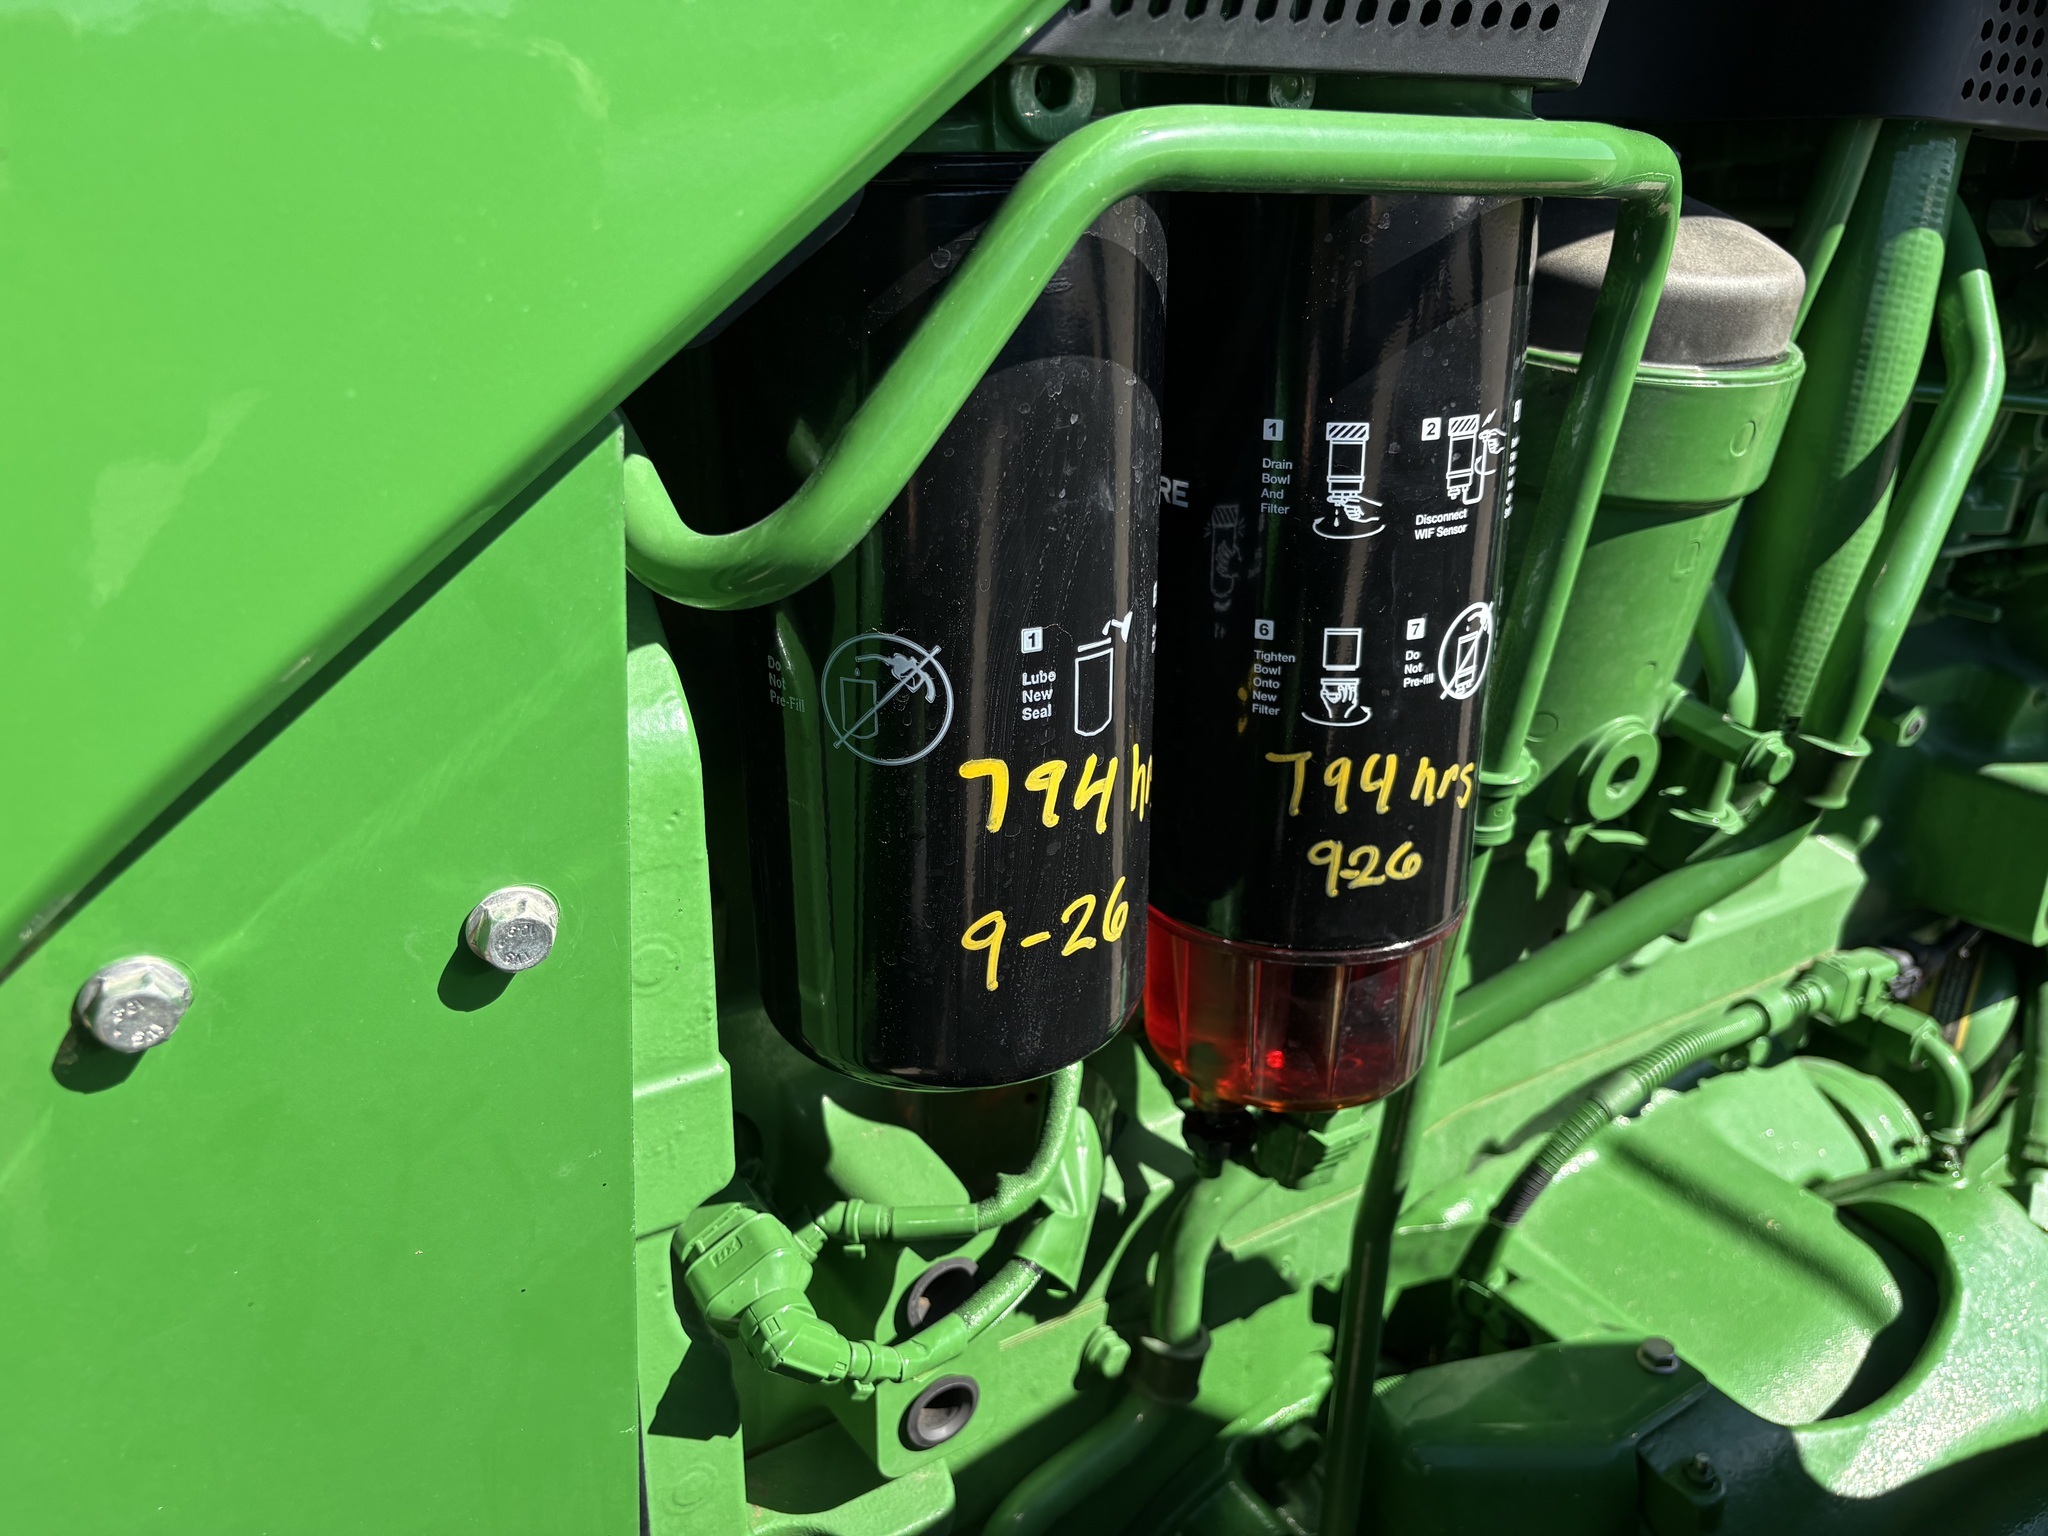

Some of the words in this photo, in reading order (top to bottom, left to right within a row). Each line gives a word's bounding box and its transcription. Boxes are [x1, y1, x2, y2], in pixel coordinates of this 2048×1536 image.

[1262, 457, 1293, 470] Drain
[1261, 473, 1291, 485] Bowl
[1260, 487, 1285, 500] And
[1260, 502, 1290, 515] Filter
[1415, 508, 1468, 526] Disconnect
[1414, 527, 1435, 540] WIF
[1436, 523, 1469, 538] Sensor
[767, 655, 782, 671] Do
[1253, 649, 1296, 663] Tighten
[1405, 650, 1421, 661] Do
[1253, 663, 1281, 676] Bowl
[1404, 662, 1424, 675] Not
[768, 672, 787, 690] Not
[1022, 669, 1057, 686] Lube
[1252, 677, 1280, 689] Onto
[1403, 672, 1435, 688] Pre-fill
[770, 689, 805, 713] Pre-Fill
[1022, 688, 1053, 704] New
[1252, 690, 1277, 702] New
[1021, 703, 1052, 721] Seal
[1251, 703, 1280, 716] Filter
[1410, 756, 1475, 810] hrs
[959, 753, 1118, 835] 794
[1307, 839, 1423, 898] 9-26
[961, 876, 1129, 992] 9-26
